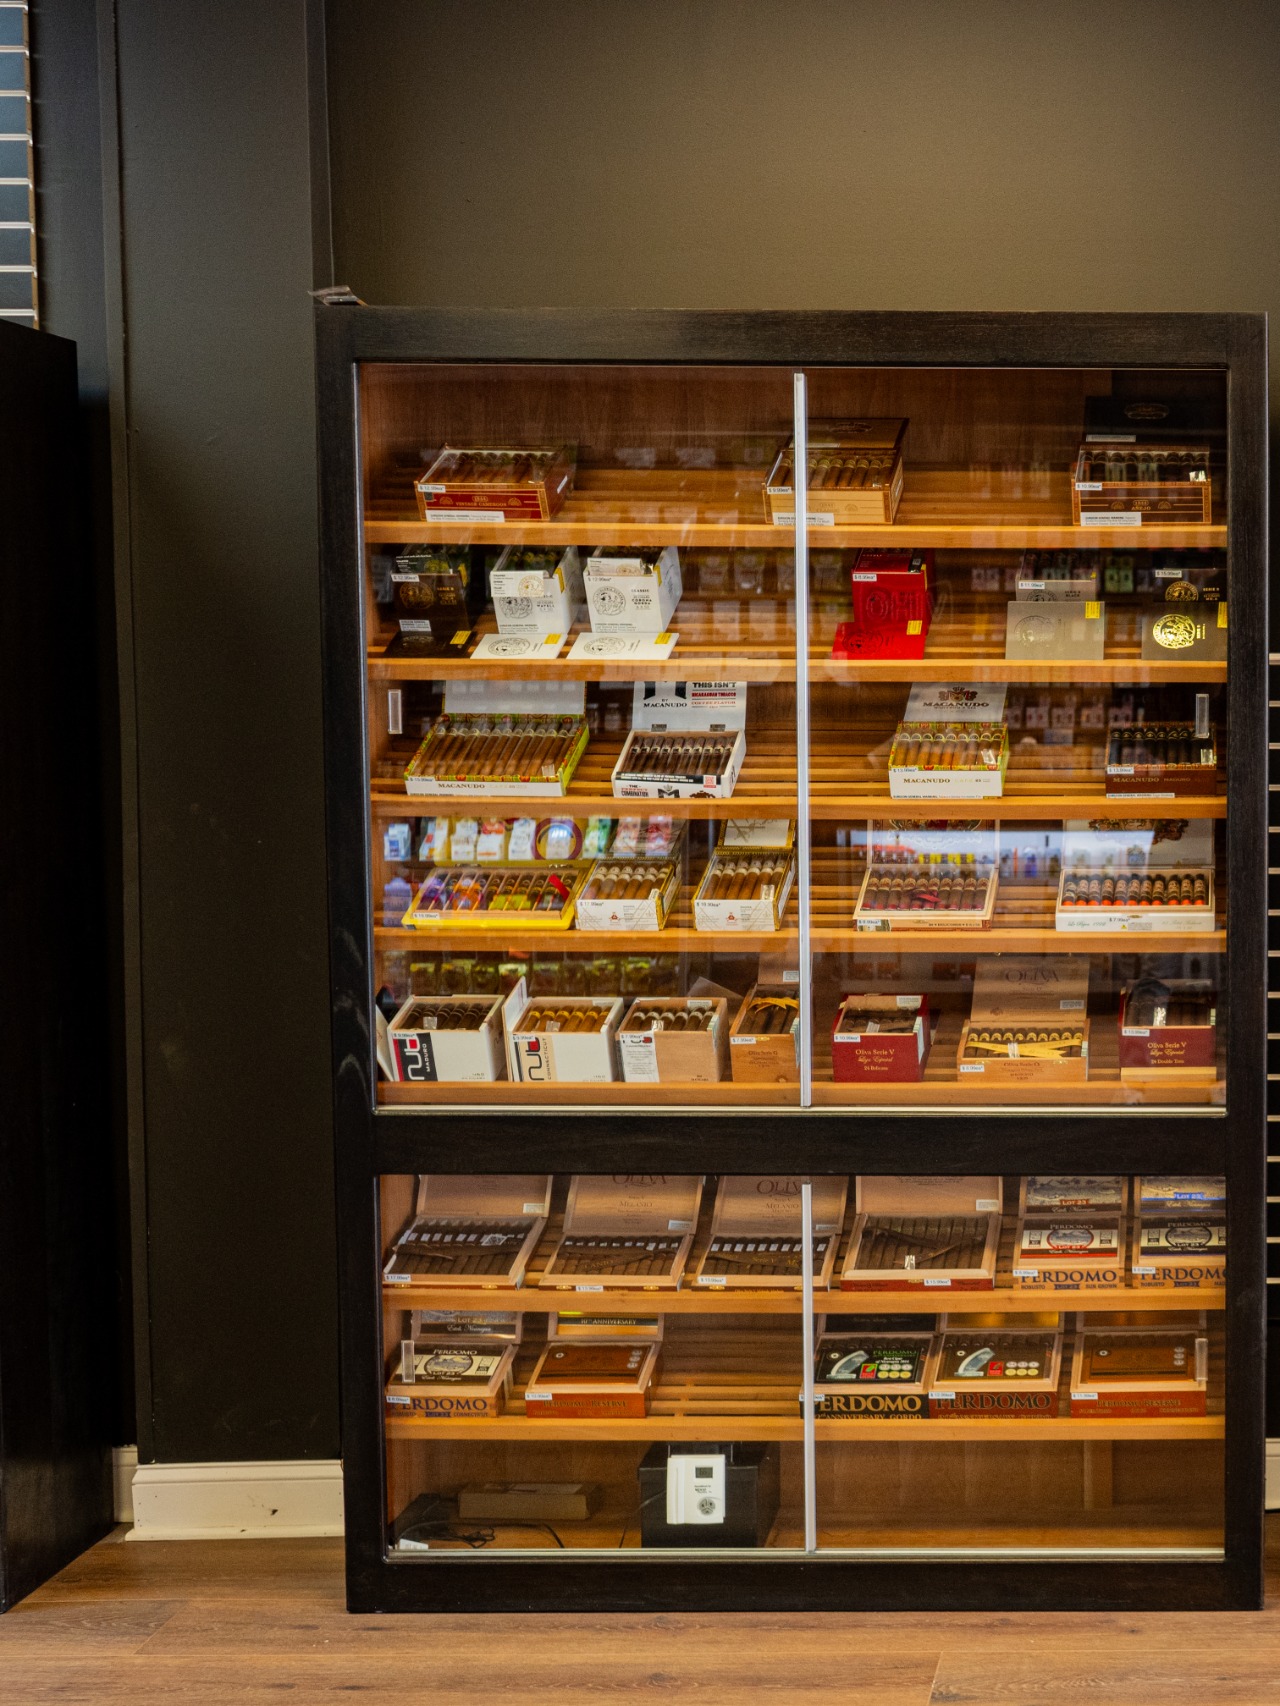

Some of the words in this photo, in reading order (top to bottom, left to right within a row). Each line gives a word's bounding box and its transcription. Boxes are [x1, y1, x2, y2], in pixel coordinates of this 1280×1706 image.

[1005, 969, 1059, 983] OLIVA
[422, 1043, 431, 1072] MADURO
[756, 1180, 802, 1195] OLIV
[1141, 1268, 1226, 1280] ERDOM
[391, 1398, 488, 1411] ERDOMO
[815, 1395, 922, 1412] ERDOMO
